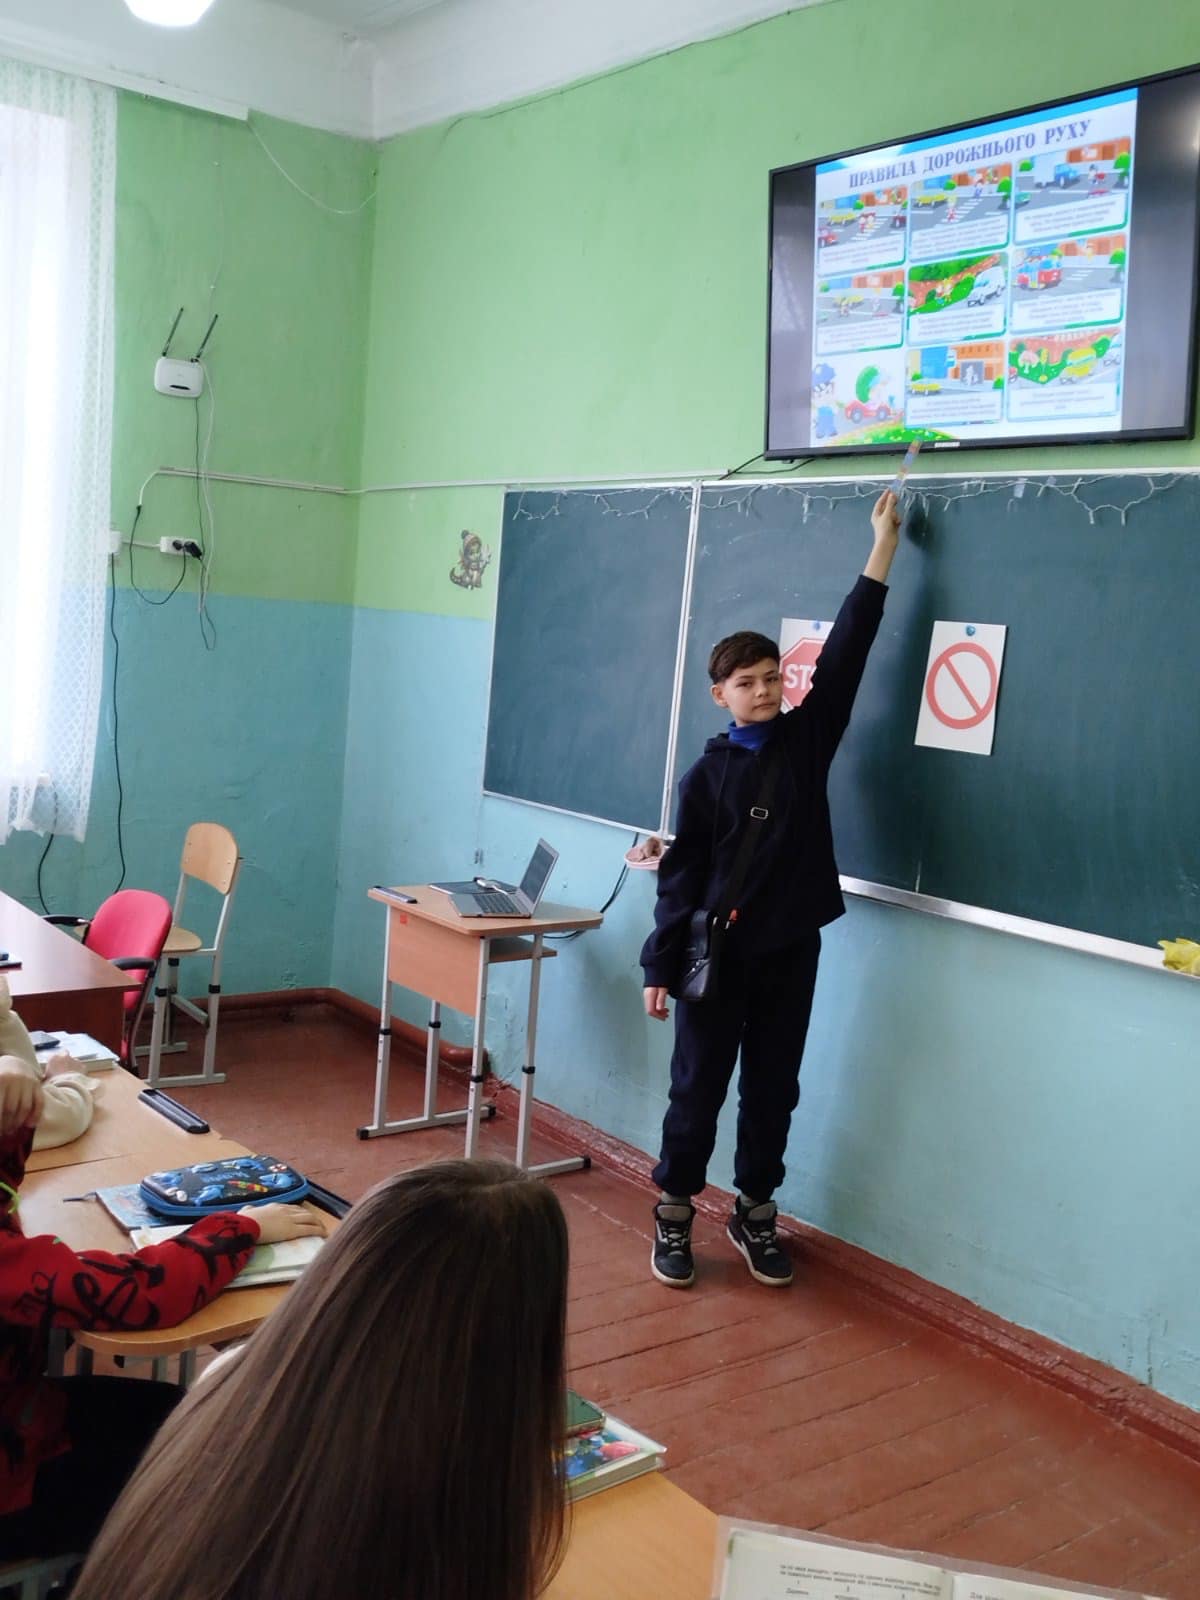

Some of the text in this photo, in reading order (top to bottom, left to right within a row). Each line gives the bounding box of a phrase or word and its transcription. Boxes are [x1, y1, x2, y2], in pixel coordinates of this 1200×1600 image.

[849, 118, 1093, 188] ПРАВИЛА ДОРОЖНЬОГО РУХУ
[784, 663, 818, 691] ST
